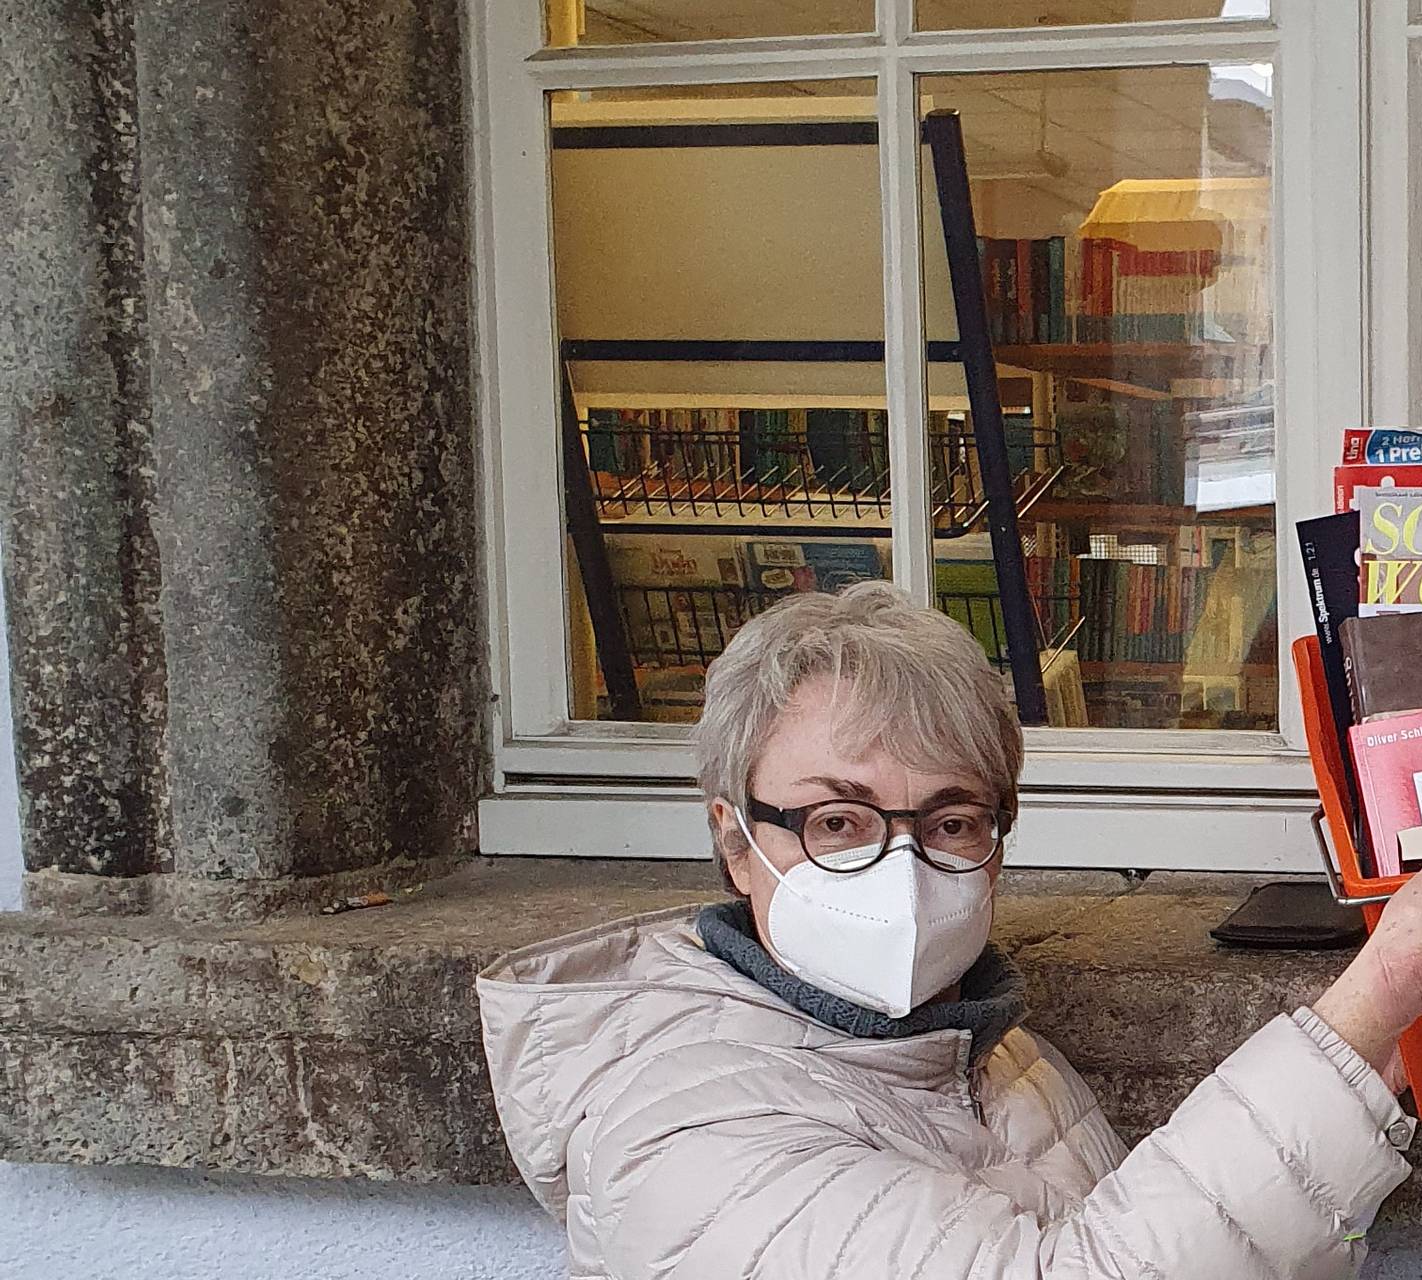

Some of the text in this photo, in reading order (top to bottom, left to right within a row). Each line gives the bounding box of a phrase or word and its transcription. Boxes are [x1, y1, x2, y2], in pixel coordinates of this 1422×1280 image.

[1346, 437, 1360, 460] tina
[1381, 436, 1390, 446] 2
[1376, 448, 1385, 463] 1
[1366, 732, 1397, 747] Oliver
